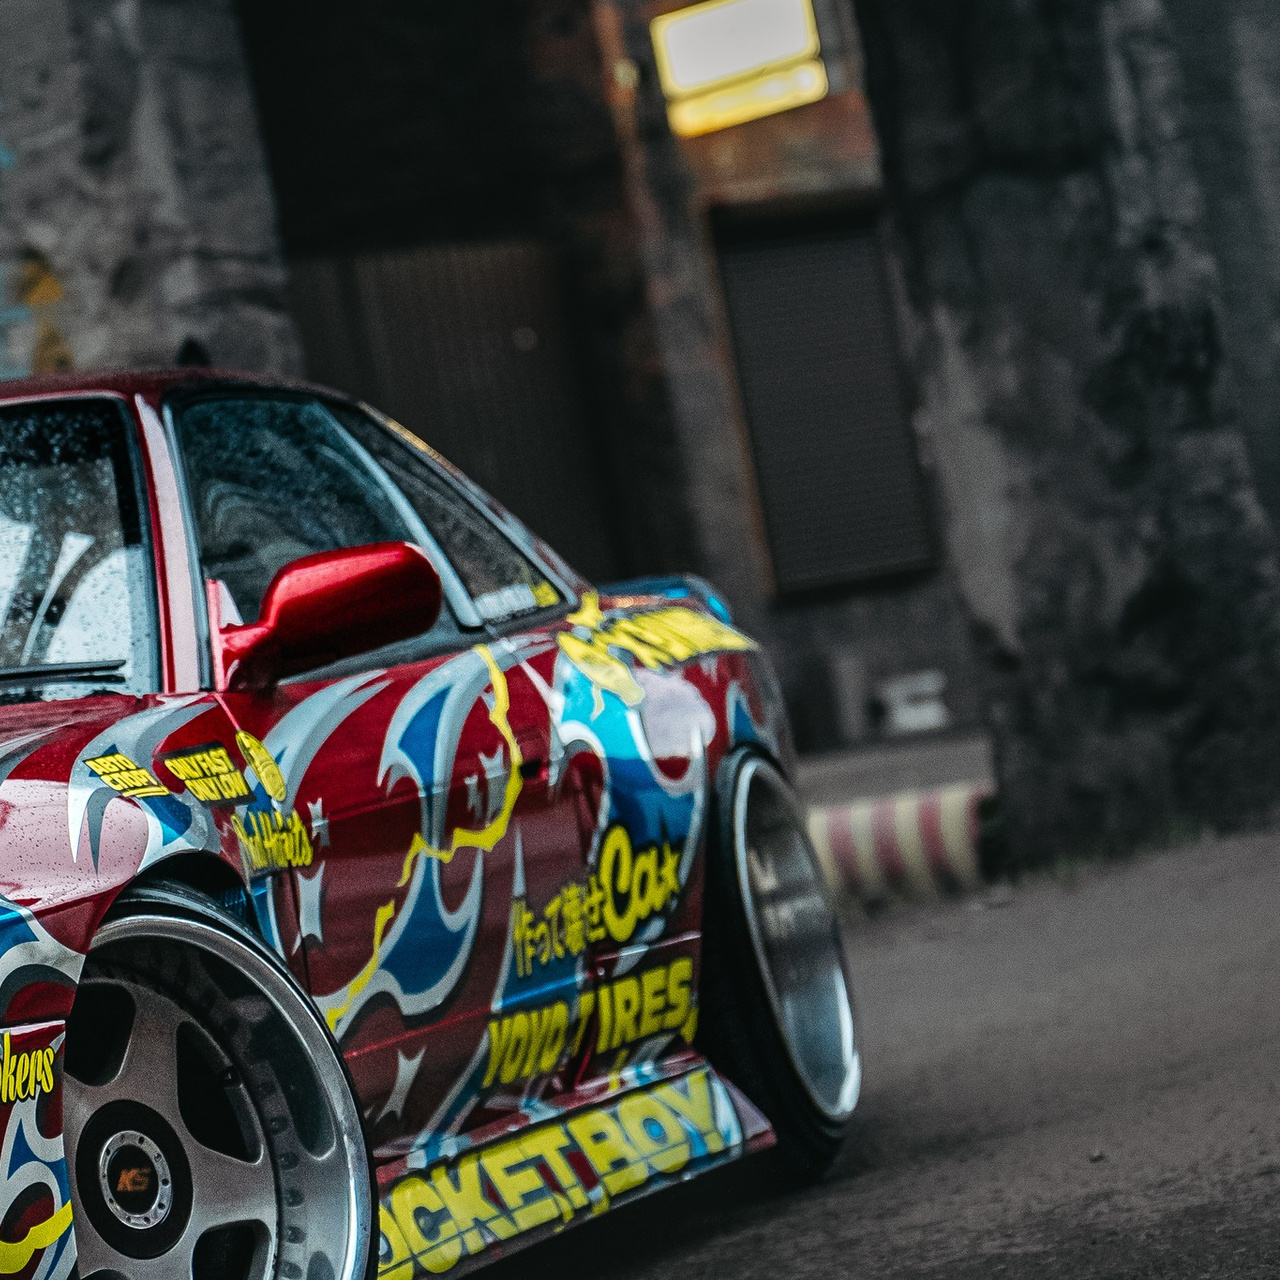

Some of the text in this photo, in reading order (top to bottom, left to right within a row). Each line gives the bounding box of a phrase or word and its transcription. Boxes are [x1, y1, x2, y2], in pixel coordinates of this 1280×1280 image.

[87, 753, 137, 776] АВТО
[164, 746, 236, 781] ONLY FAST
[100, 768, 159, 791] СПОРТ
[185, 771, 250, 802] ONLY LOW
